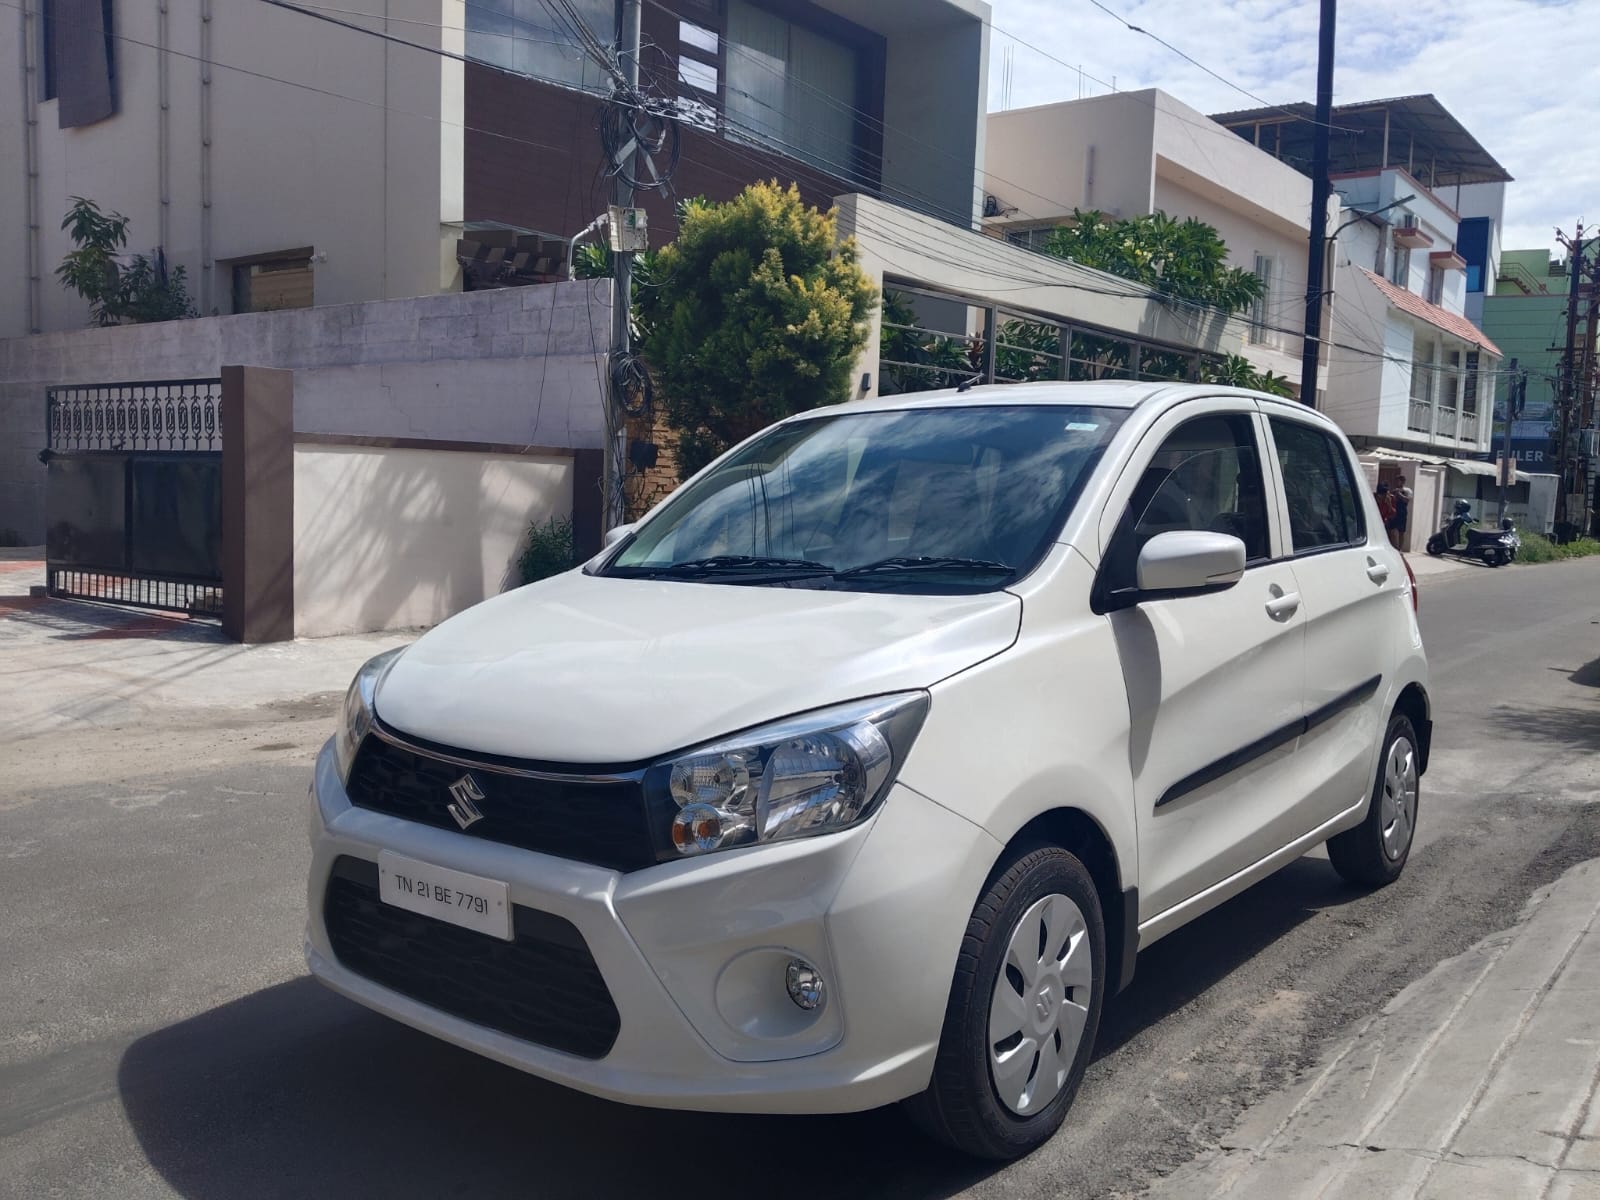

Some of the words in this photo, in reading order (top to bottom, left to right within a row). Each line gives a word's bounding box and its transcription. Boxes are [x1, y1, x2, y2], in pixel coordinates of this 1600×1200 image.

[395, 874, 413, 893] TN
[417, 881, 430, 898] 21
[434, 886, 452, 905] BE
[455, 891, 488, 915] 7791
